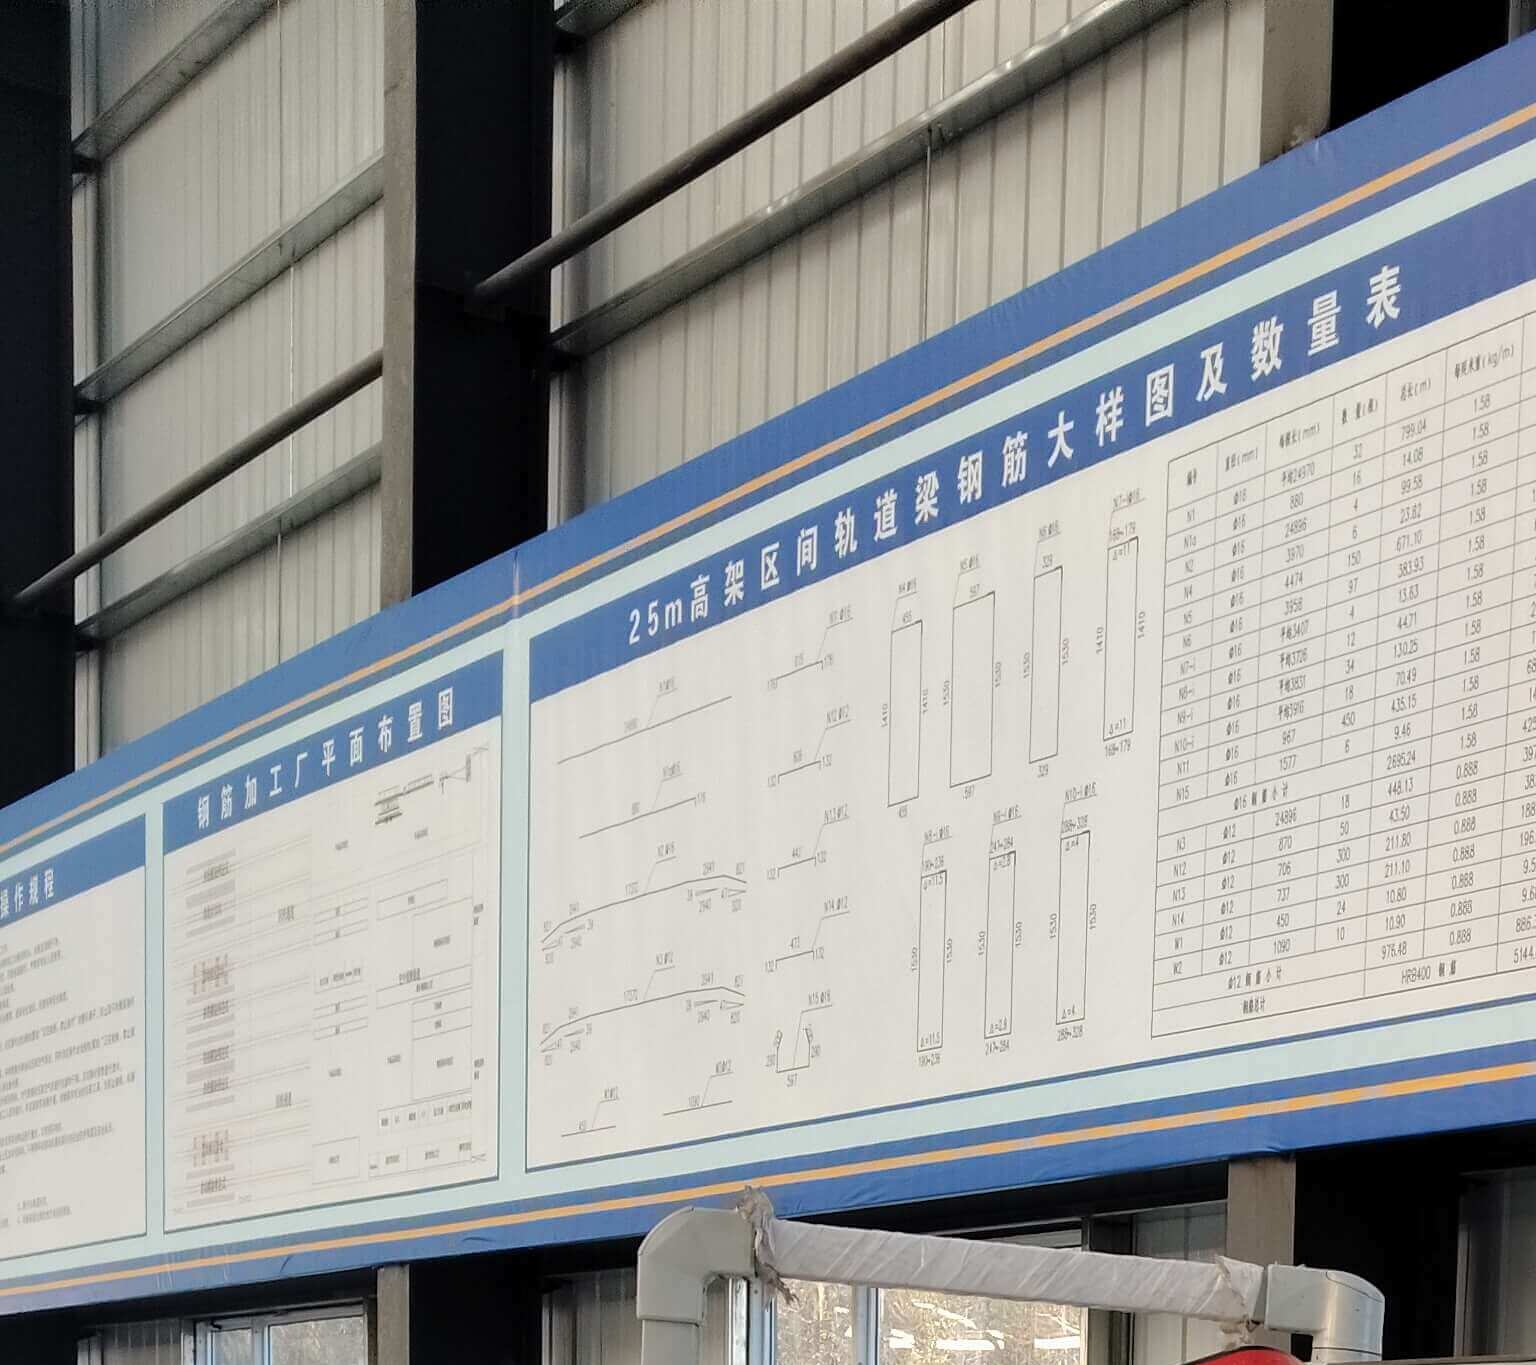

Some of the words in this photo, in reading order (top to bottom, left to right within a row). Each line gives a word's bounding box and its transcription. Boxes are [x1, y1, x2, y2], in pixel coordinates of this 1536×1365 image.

[1473, 391, 1490, 413] 1.58
[1472, 420, 1489, 441] 1.58
[1471, 448, 1488, 469] 1.58
[1470, 476, 1487, 498] 1.58
[1469, 505, 1486, 525] 1.58
[1468, 533, 1485, 554] 1.58
[1467, 561, 1484, 582] 1.58
[1466, 589, 1483, 610] 1.58
[1464, 617, 1481, 638] 1.58
[1464, 646, 1480, 666] 1.58
[1462, 674, 1479, 693] 1.58
[1461, 701, 1478, 721] 1.58
[1460, 730, 1477, 750] 1.58
[198, 687, 453, 829] 钢筋加工厂平面布置图
[1456, 759, 1478, 780] 0.888
[1454, 787, 1477, 807] 0.888
[1453, 815, 1476, 835] 0.888
[1452, 842, 1475, 863] 0.888
[1450, 870, 1473, 890] 0.888
[1450, 898, 1472, 918] 0.888
[1449, 927, 1471, 946] 0.888
